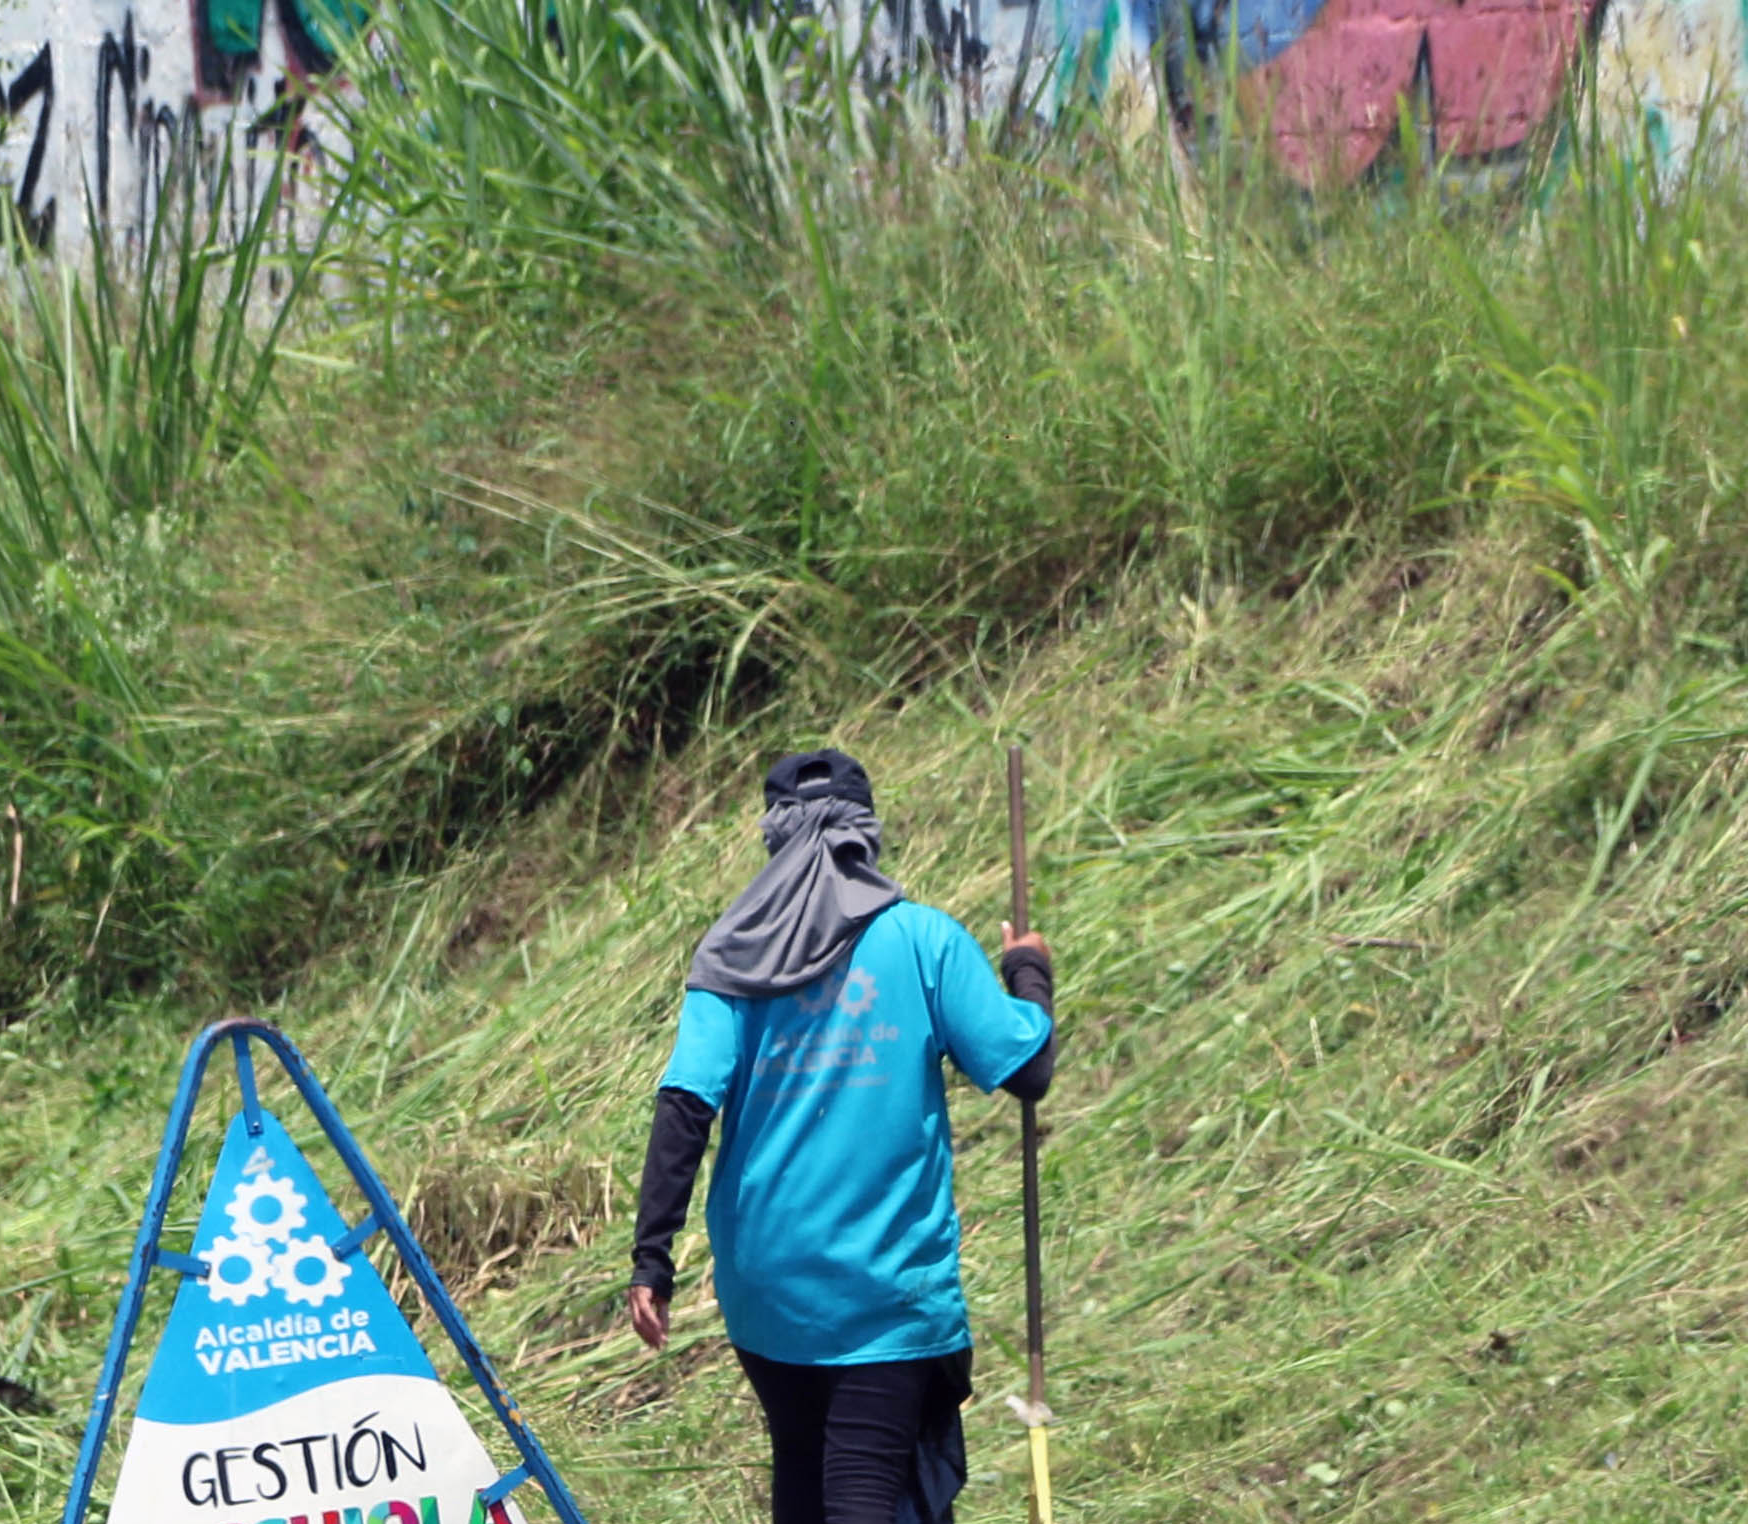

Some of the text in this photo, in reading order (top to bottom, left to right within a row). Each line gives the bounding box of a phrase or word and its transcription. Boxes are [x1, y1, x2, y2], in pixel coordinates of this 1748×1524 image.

[195, 1307, 370, 1351] Alcaldía de
[195, 1329, 377, 1376] VALENCIA
[182, 1411, 427, 1508] GESTIÓN
